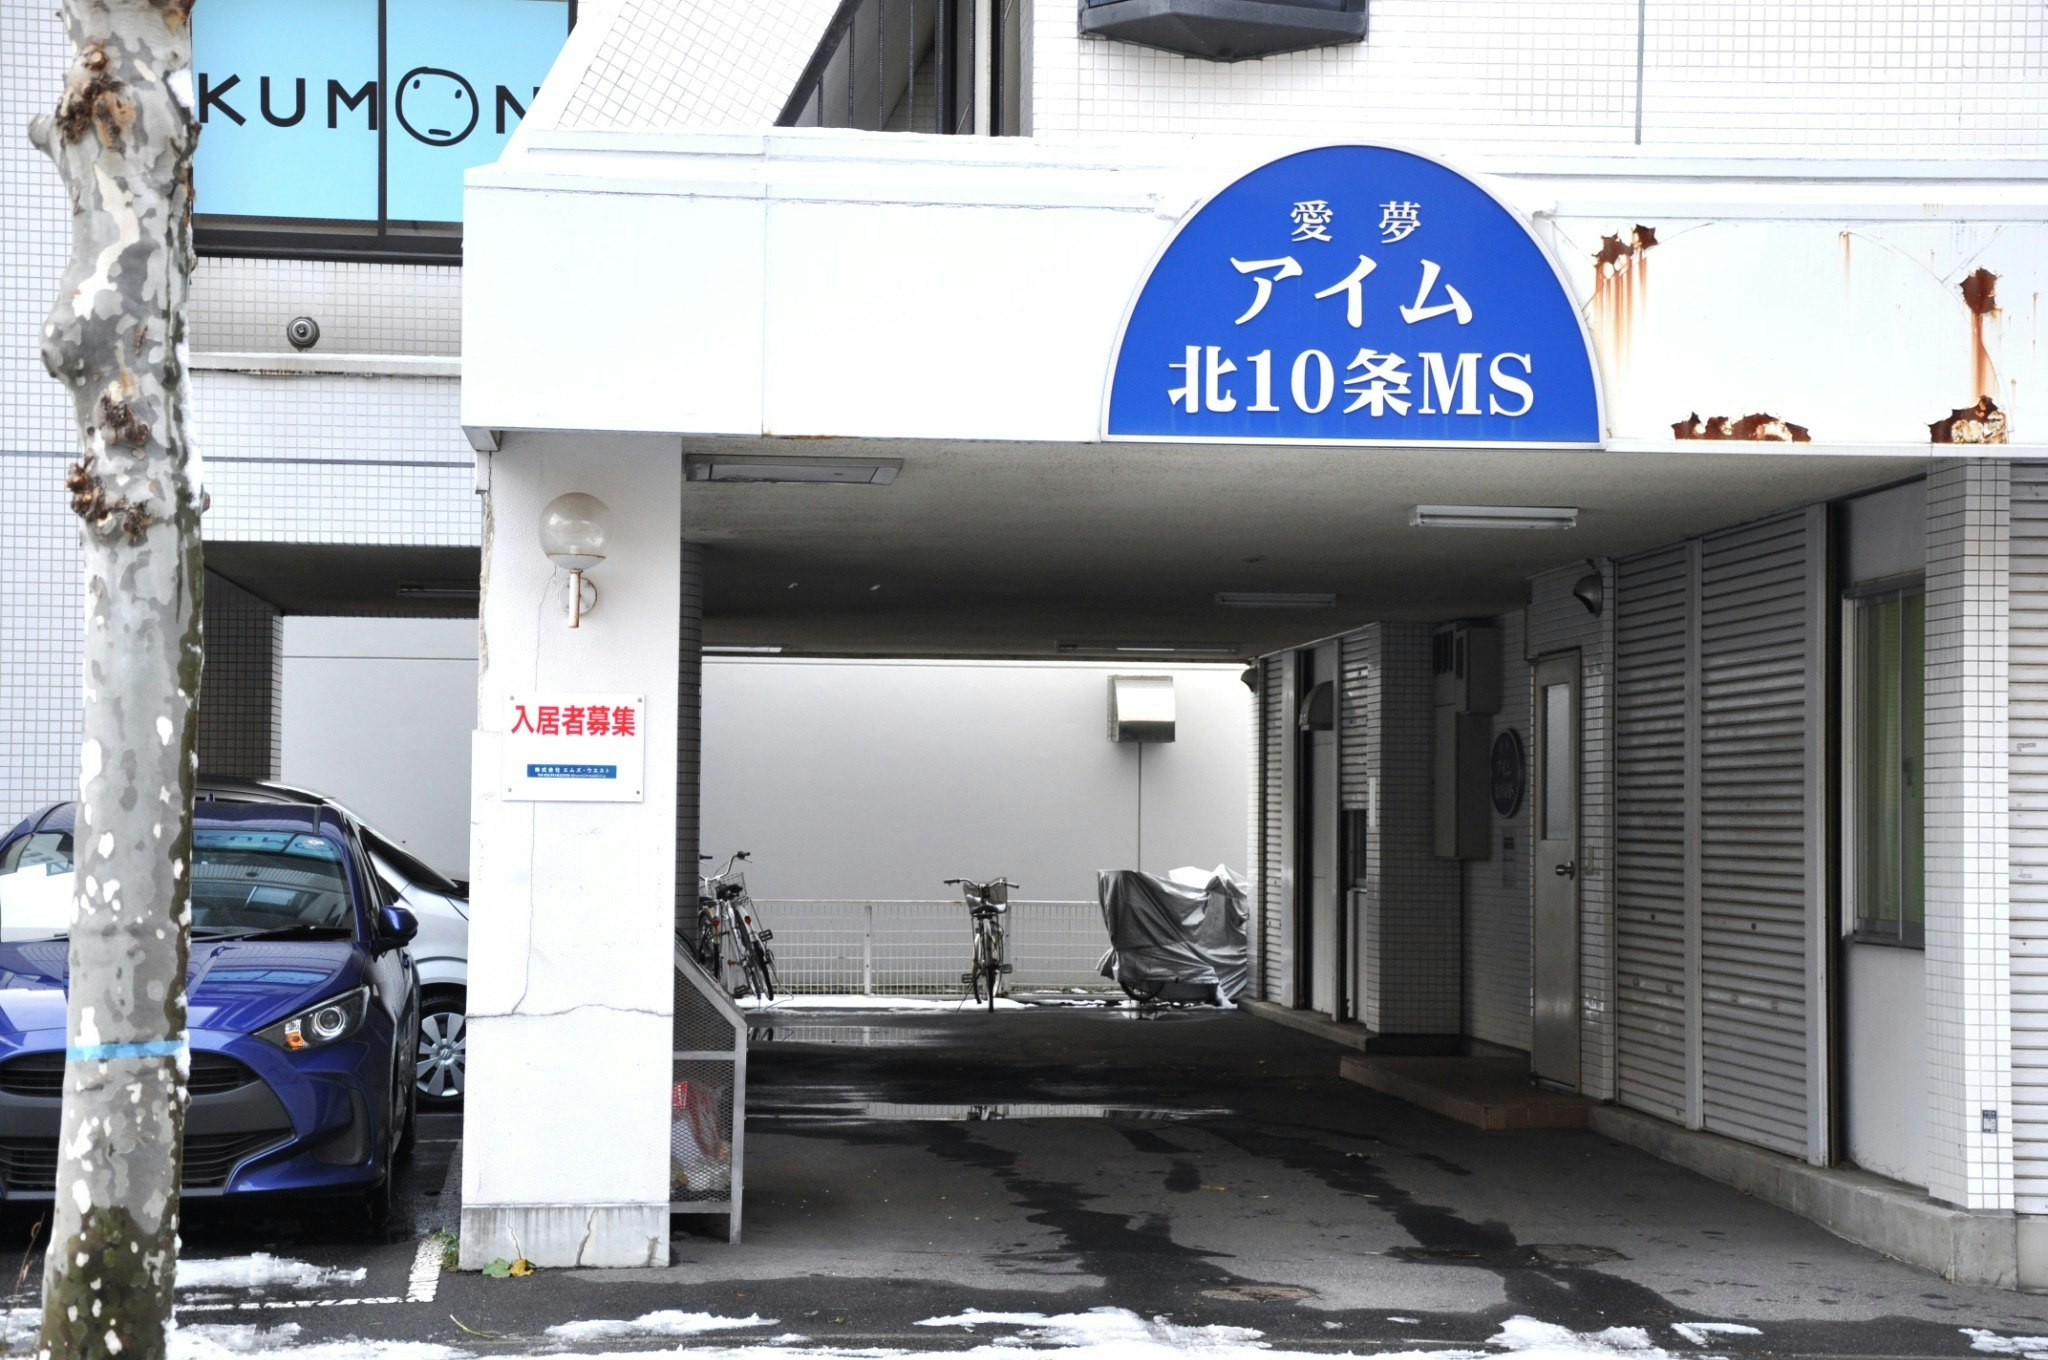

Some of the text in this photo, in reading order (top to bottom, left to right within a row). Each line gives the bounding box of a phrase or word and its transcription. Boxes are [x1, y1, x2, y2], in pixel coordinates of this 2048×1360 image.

[198, 66, 541, 147] KUMON
[1230, 254, 1473, 328] アイム
[1167, 345, 1534, 418] 北10条MS
[511, 704, 635, 737] 入居者募集
